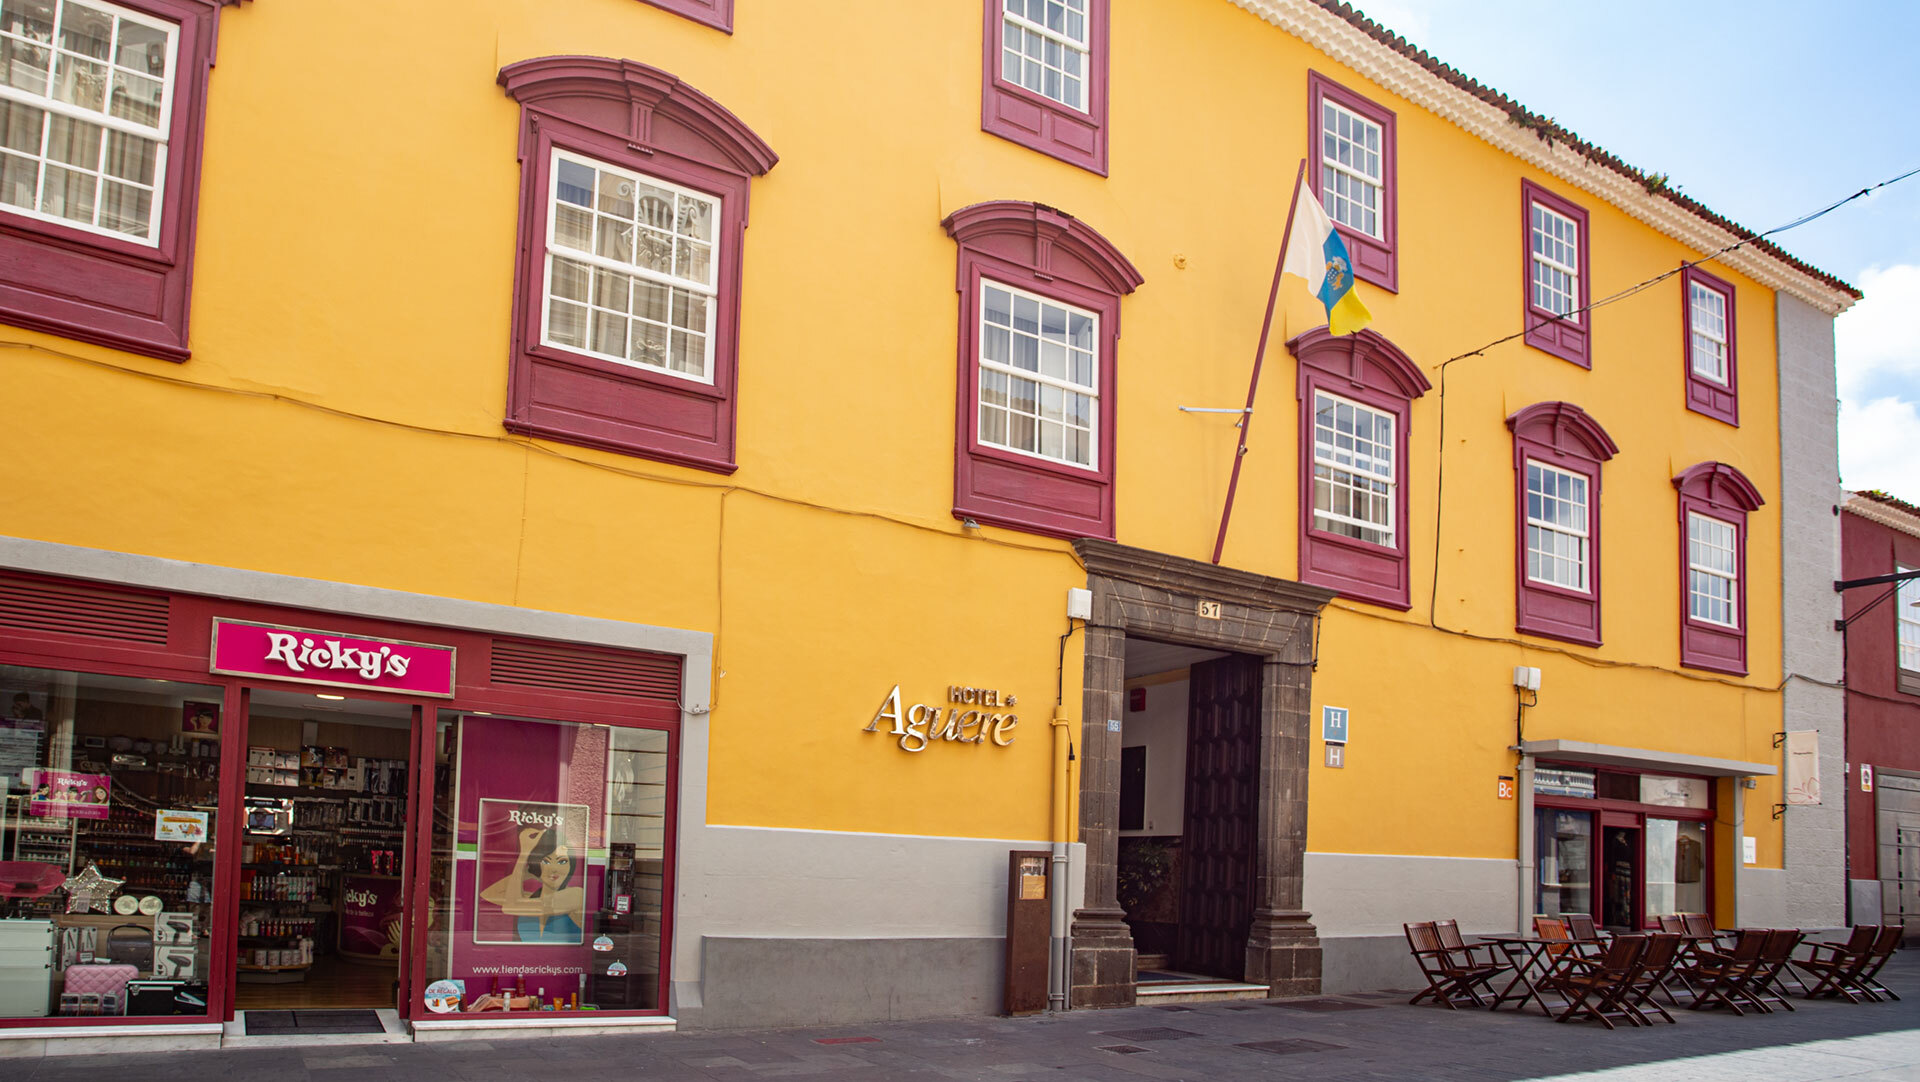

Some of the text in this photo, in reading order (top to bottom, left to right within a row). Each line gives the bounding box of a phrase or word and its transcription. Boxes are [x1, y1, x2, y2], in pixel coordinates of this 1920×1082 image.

[1202, 602, 1218, 616] 57
[264, 632, 411, 680] Ricky's
[948, 685, 1005, 707] HOTEL
[863, 684, 1019, 752] Aguere
[1330, 711, 1342, 729] H
[1329, 748, 1340, 766] H
[57, 777, 88, 787] Ricky's
[1498, 782, 1513, 798] Bc
[508, 809, 564, 828] Ricky's
[472, 964, 583, 976] www.tiendasrickys.com
